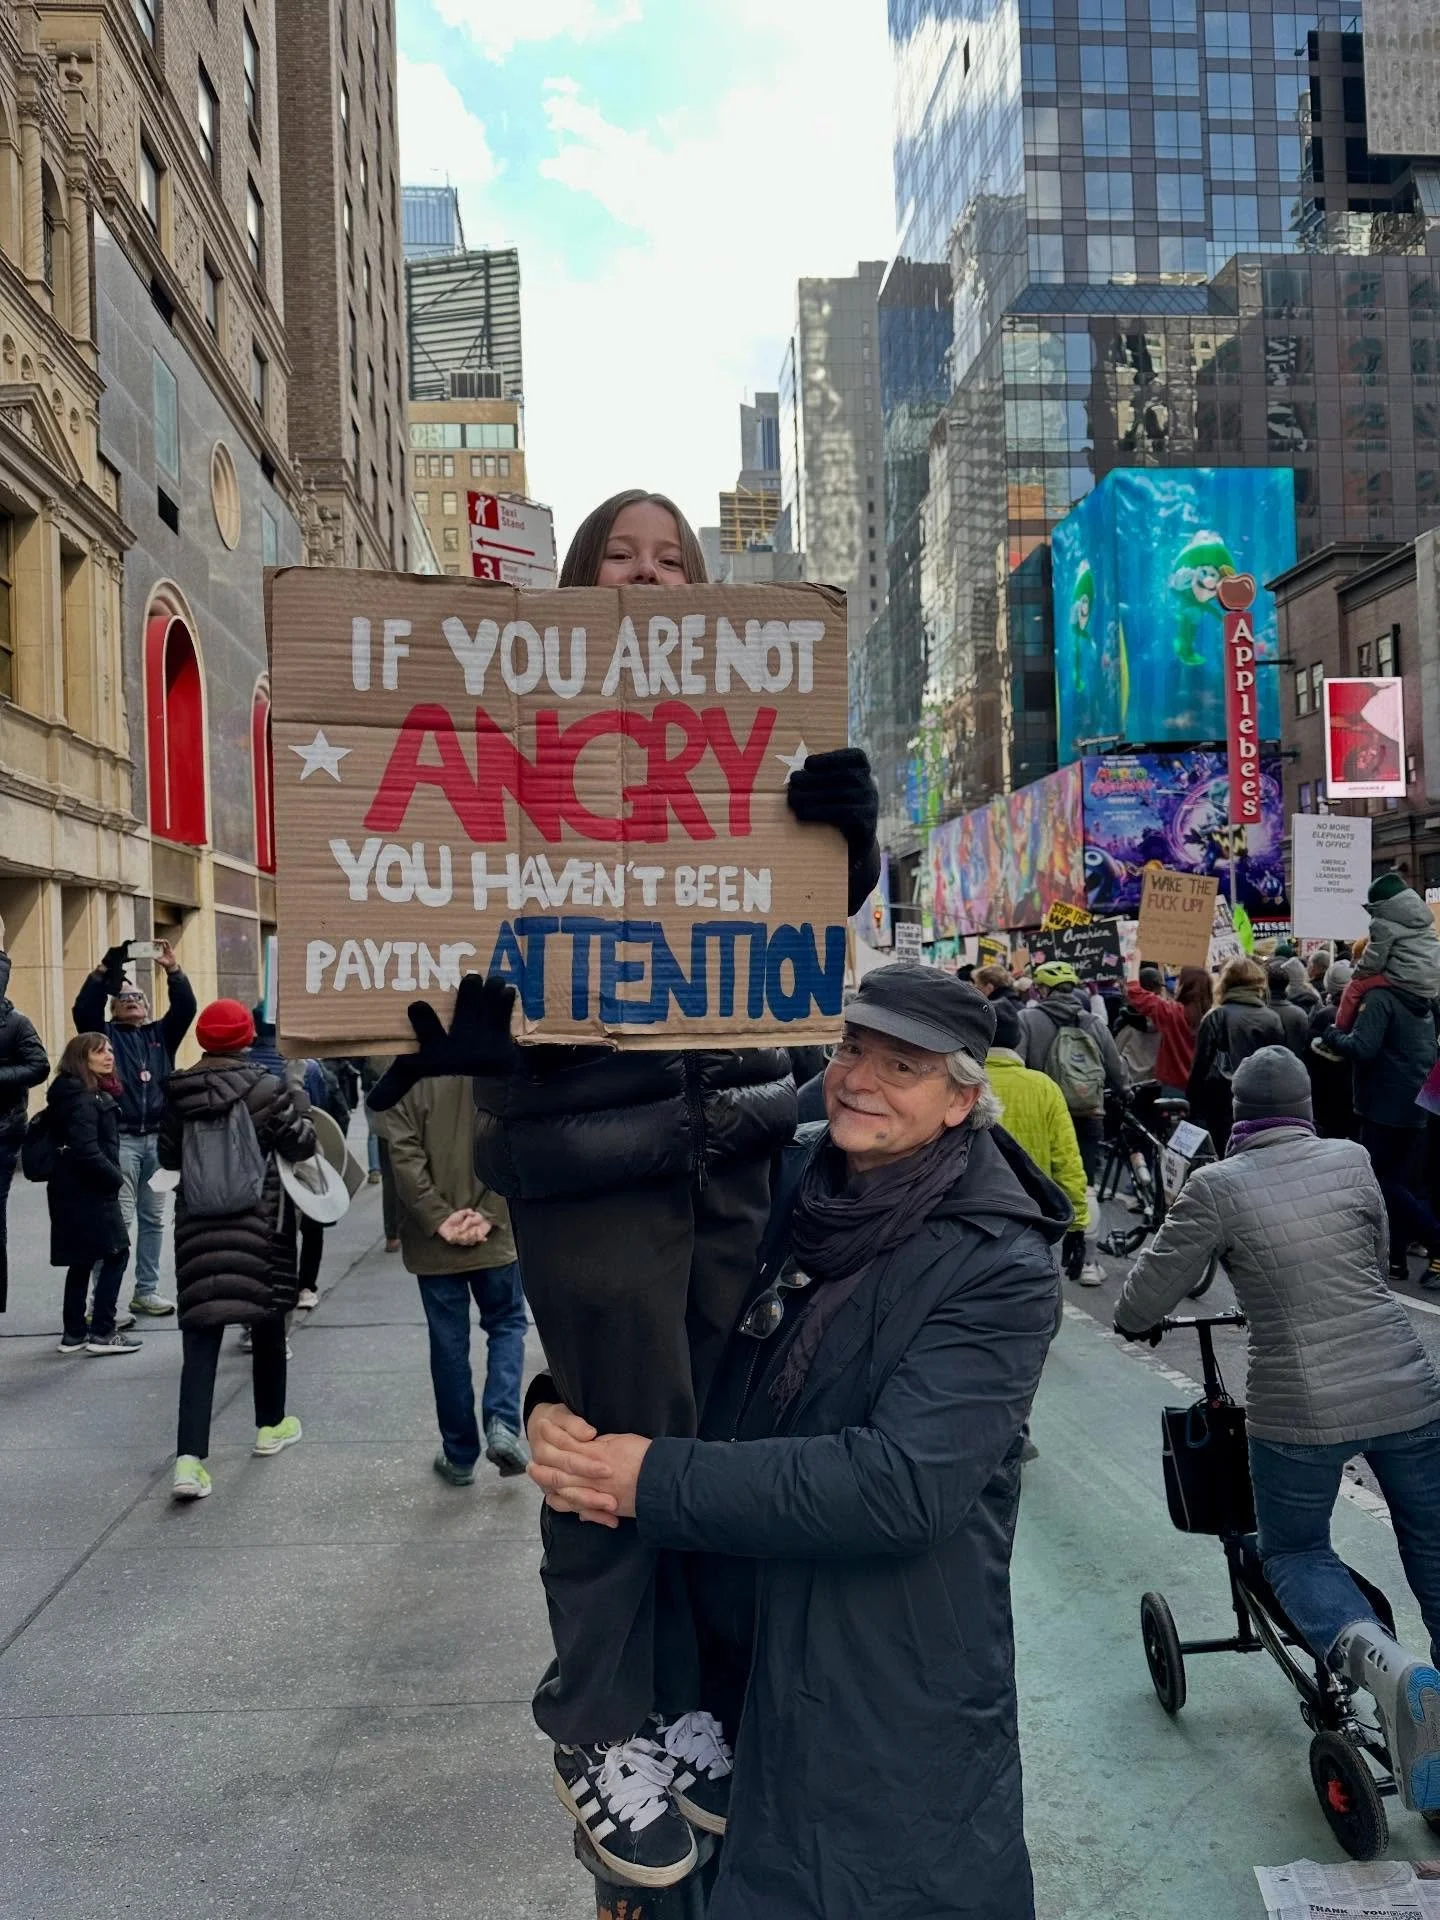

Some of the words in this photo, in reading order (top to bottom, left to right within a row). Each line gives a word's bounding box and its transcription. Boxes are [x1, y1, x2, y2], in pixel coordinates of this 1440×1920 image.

[501, 506, 518, 518] Taxi
[502, 516, 525, 531] Stand
[480, 557, 496, 581] 3
[352, 616, 412, 692] IF
[442, 616, 587, 699] YOU
[601, 615, 706, 698] ARE
[716, 617, 826, 695] NOT
[1230, 618, 1258, 816] Applebee's
[362, 701, 778, 843] ANGRY
[1312, 831, 1355, 840] ELEPHANTS
[1325, 841, 1352, 849] OFFICE
[330, 837, 452, 908] YOU
[471, 850, 664, 911] HAVEN'T
[675, 864, 772, 913] BEEN
[1151, 875, 1183, 893] WAKE
[1189, 878, 1213, 895] THE
[1147, 893, 1178, 912] FUCK
[1063, 928, 1112, 943] America
[306, 939, 476, 994] PAYING
[488, 916, 846, 1024] ATTENTION
[1308, 1904, 1348, 1914] THANK
